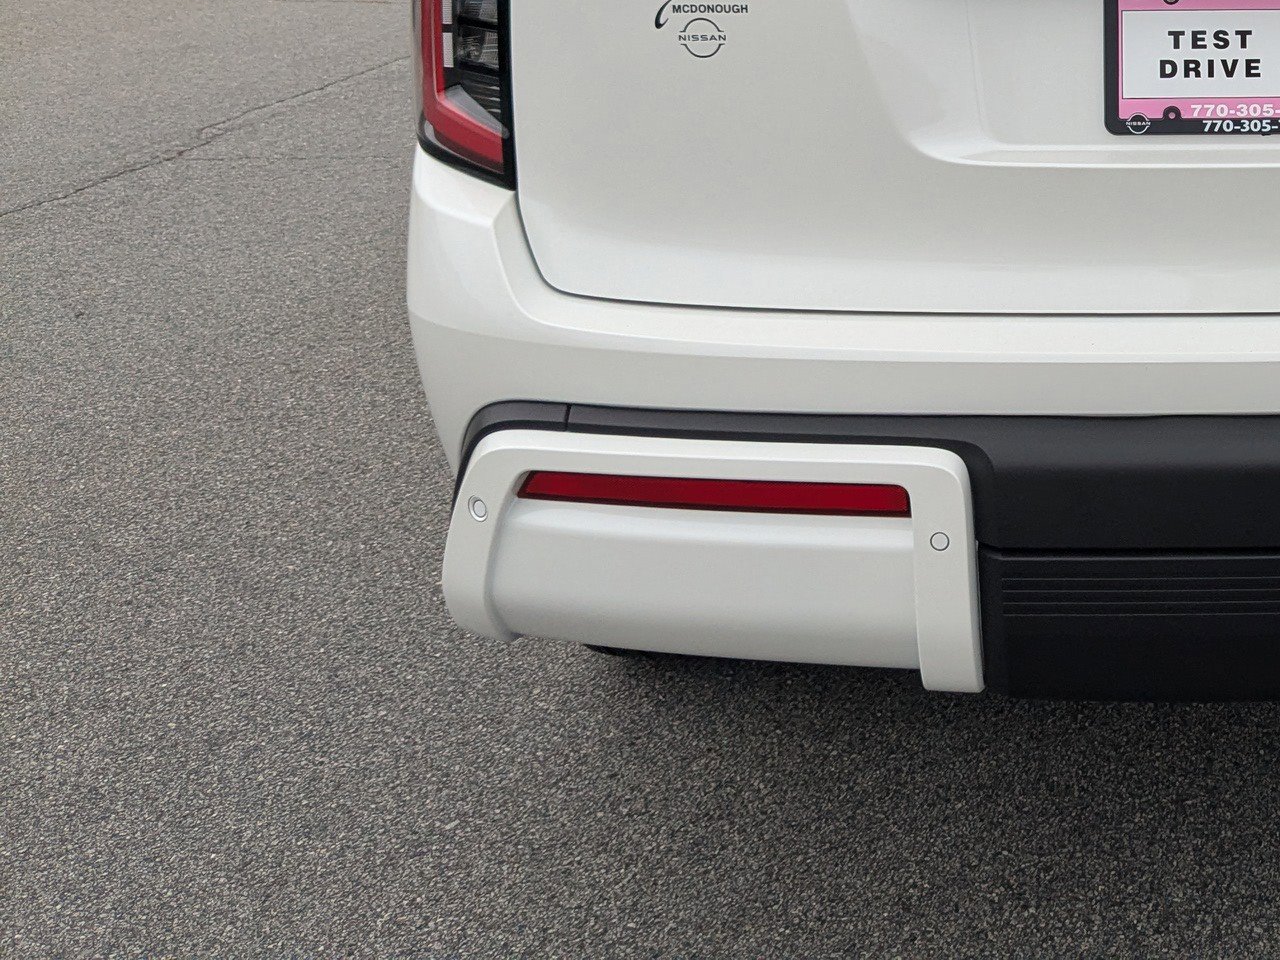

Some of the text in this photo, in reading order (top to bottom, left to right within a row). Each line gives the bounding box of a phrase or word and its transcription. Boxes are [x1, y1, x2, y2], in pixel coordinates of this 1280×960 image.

[672, 4, 749, 14] MCDONOUGH
[678, 34, 727, 42] NISSAN
[1167, 30, 1252, 50] TEST
[1159, 58, 1261, 79] DRIVE
